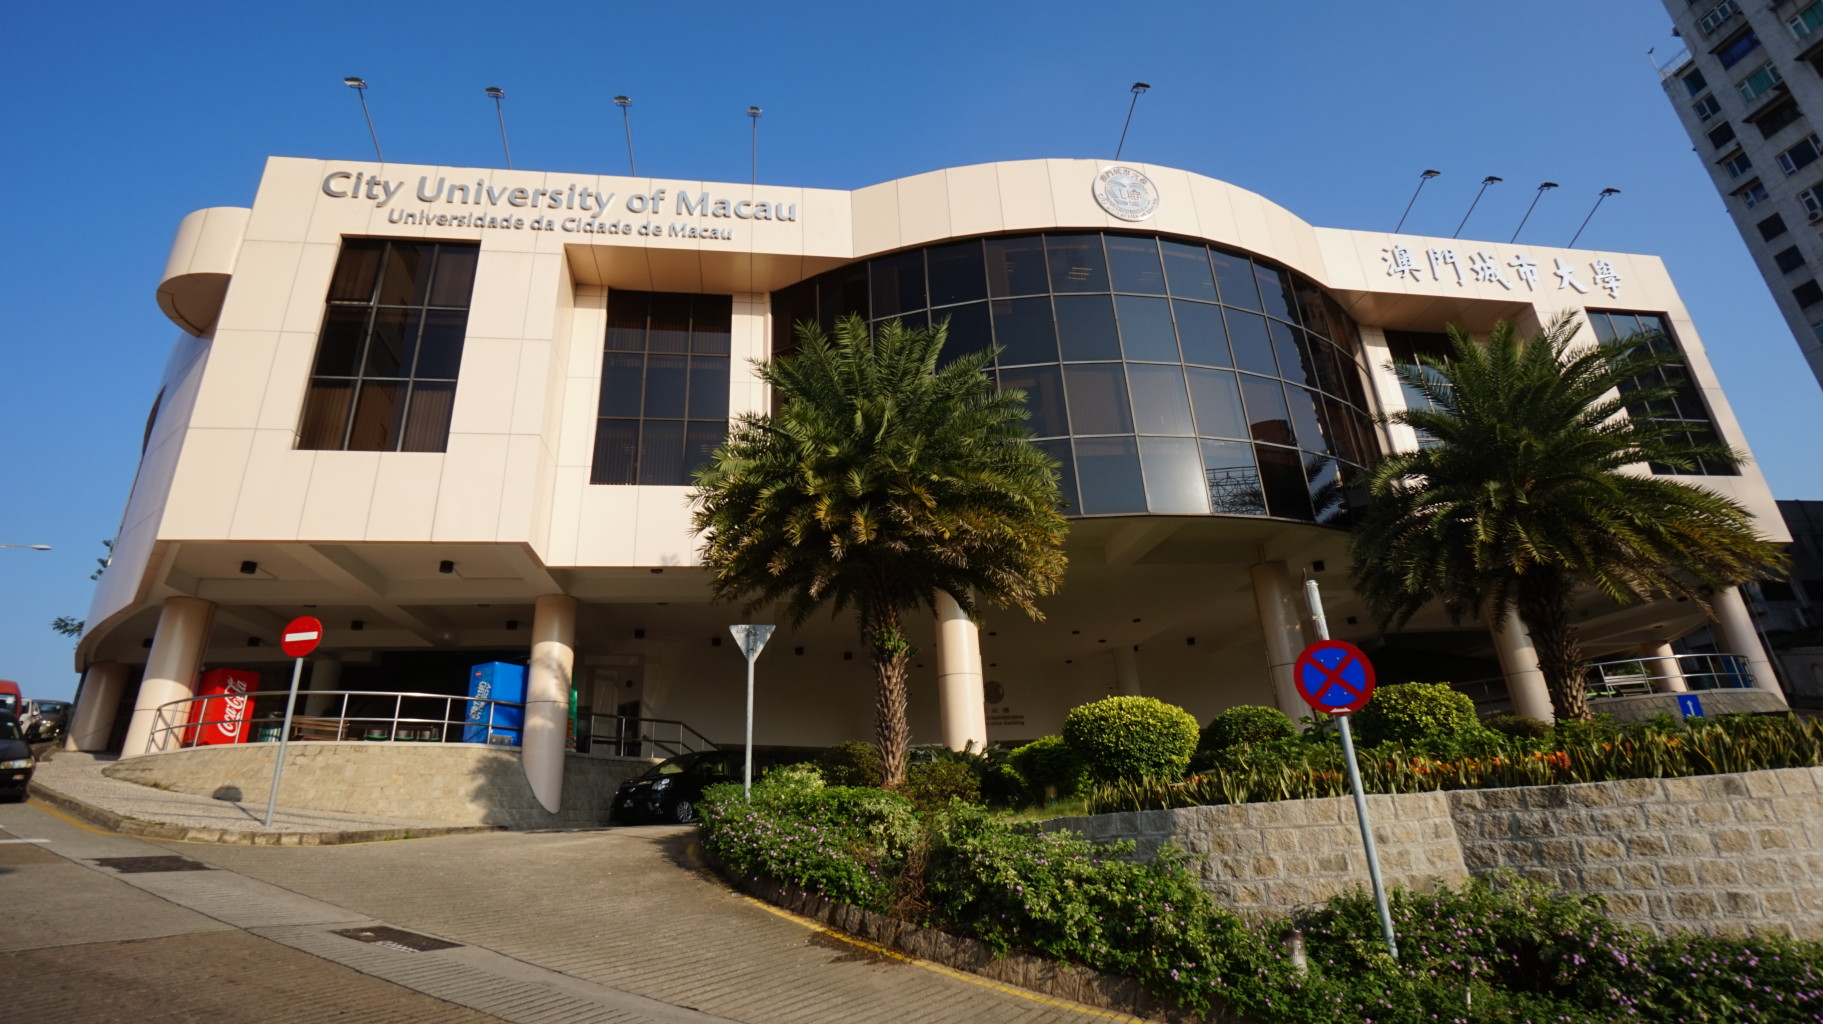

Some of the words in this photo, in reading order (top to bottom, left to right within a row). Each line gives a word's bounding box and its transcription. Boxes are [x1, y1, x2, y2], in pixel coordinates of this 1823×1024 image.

[321, 171, 405, 208] City
[416, 175, 615, 218] University
[626, 188, 666, 214] of
[676, 190, 797, 222] Macau
[387, 208, 525, 230] Universidade
[530, 215, 555, 231] da
[561, 217, 632, 235] Cidade
[637, 221, 663, 237] de
[668, 223, 733, 241] Macau
[1381, 245, 1622, 299] 澳門城市大學
